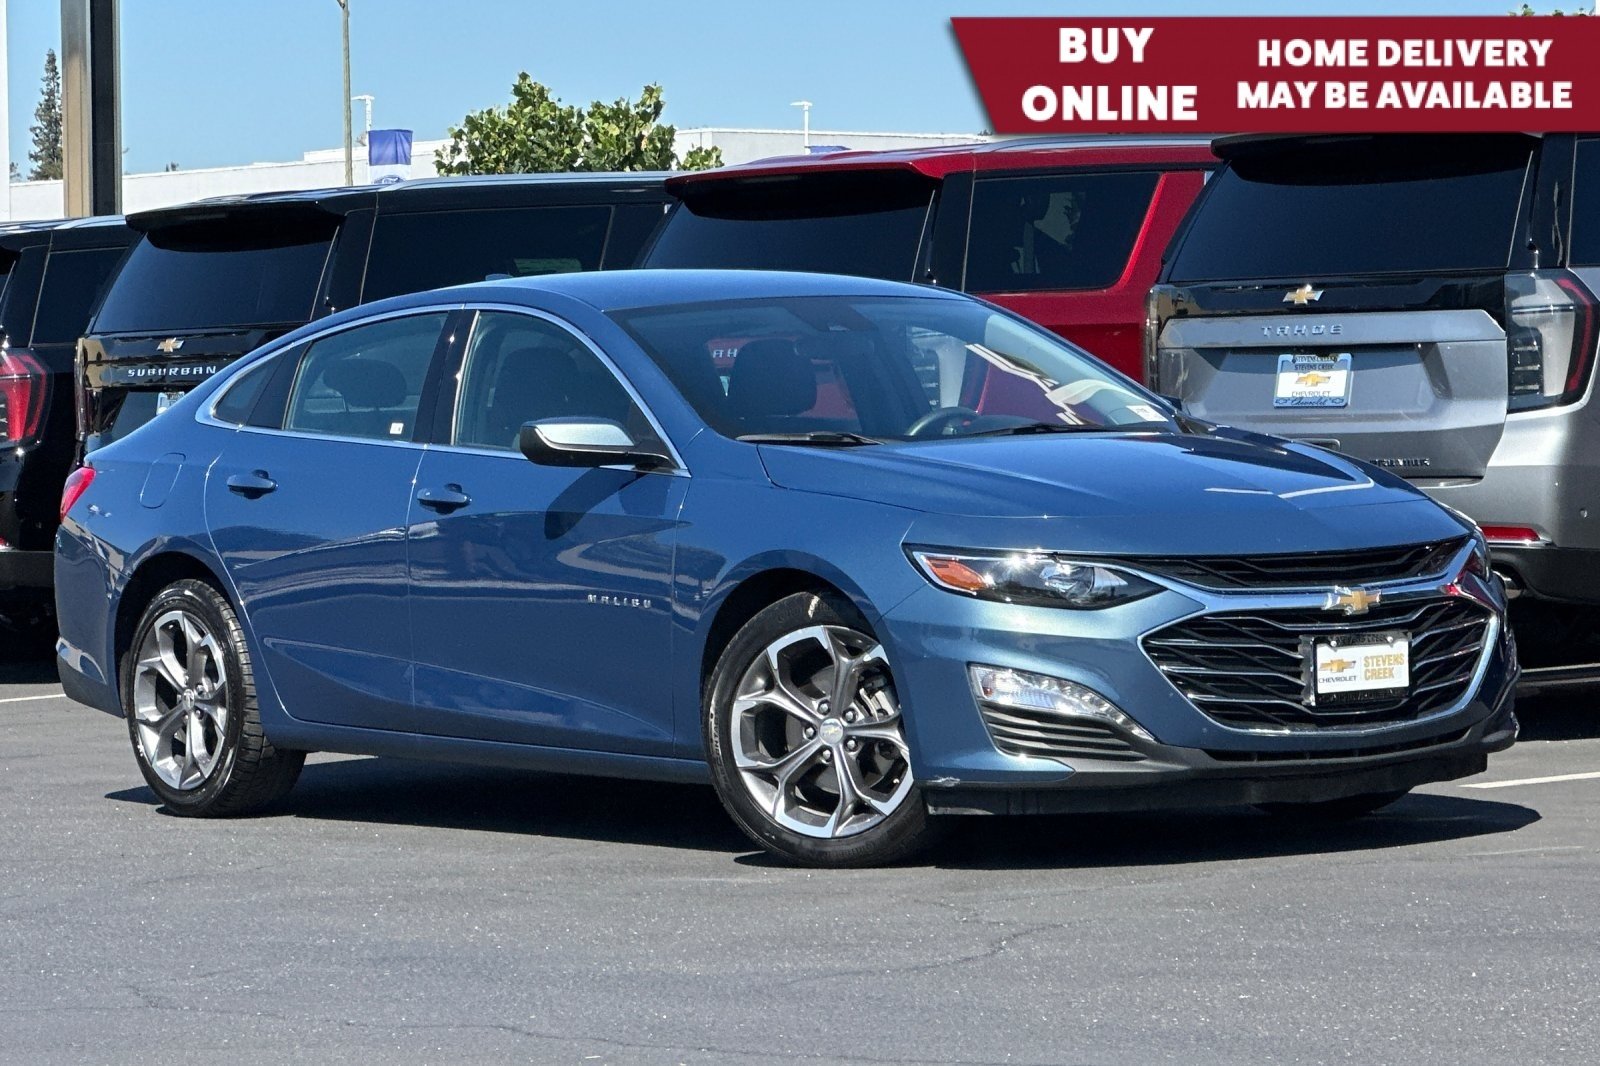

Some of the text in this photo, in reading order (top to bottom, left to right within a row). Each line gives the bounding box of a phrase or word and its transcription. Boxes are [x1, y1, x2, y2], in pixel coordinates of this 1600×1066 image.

[1260, 324, 1344, 337] TAHOE
[127, 365, 217, 377] SUBURBAN
[587, 594, 651, 609] MALIBU
[1363, 653, 1405, 668] STEVENS
[1318, 675, 1357, 684] CHEVROLET
[1363, 666, 1394, 681] CREEK
